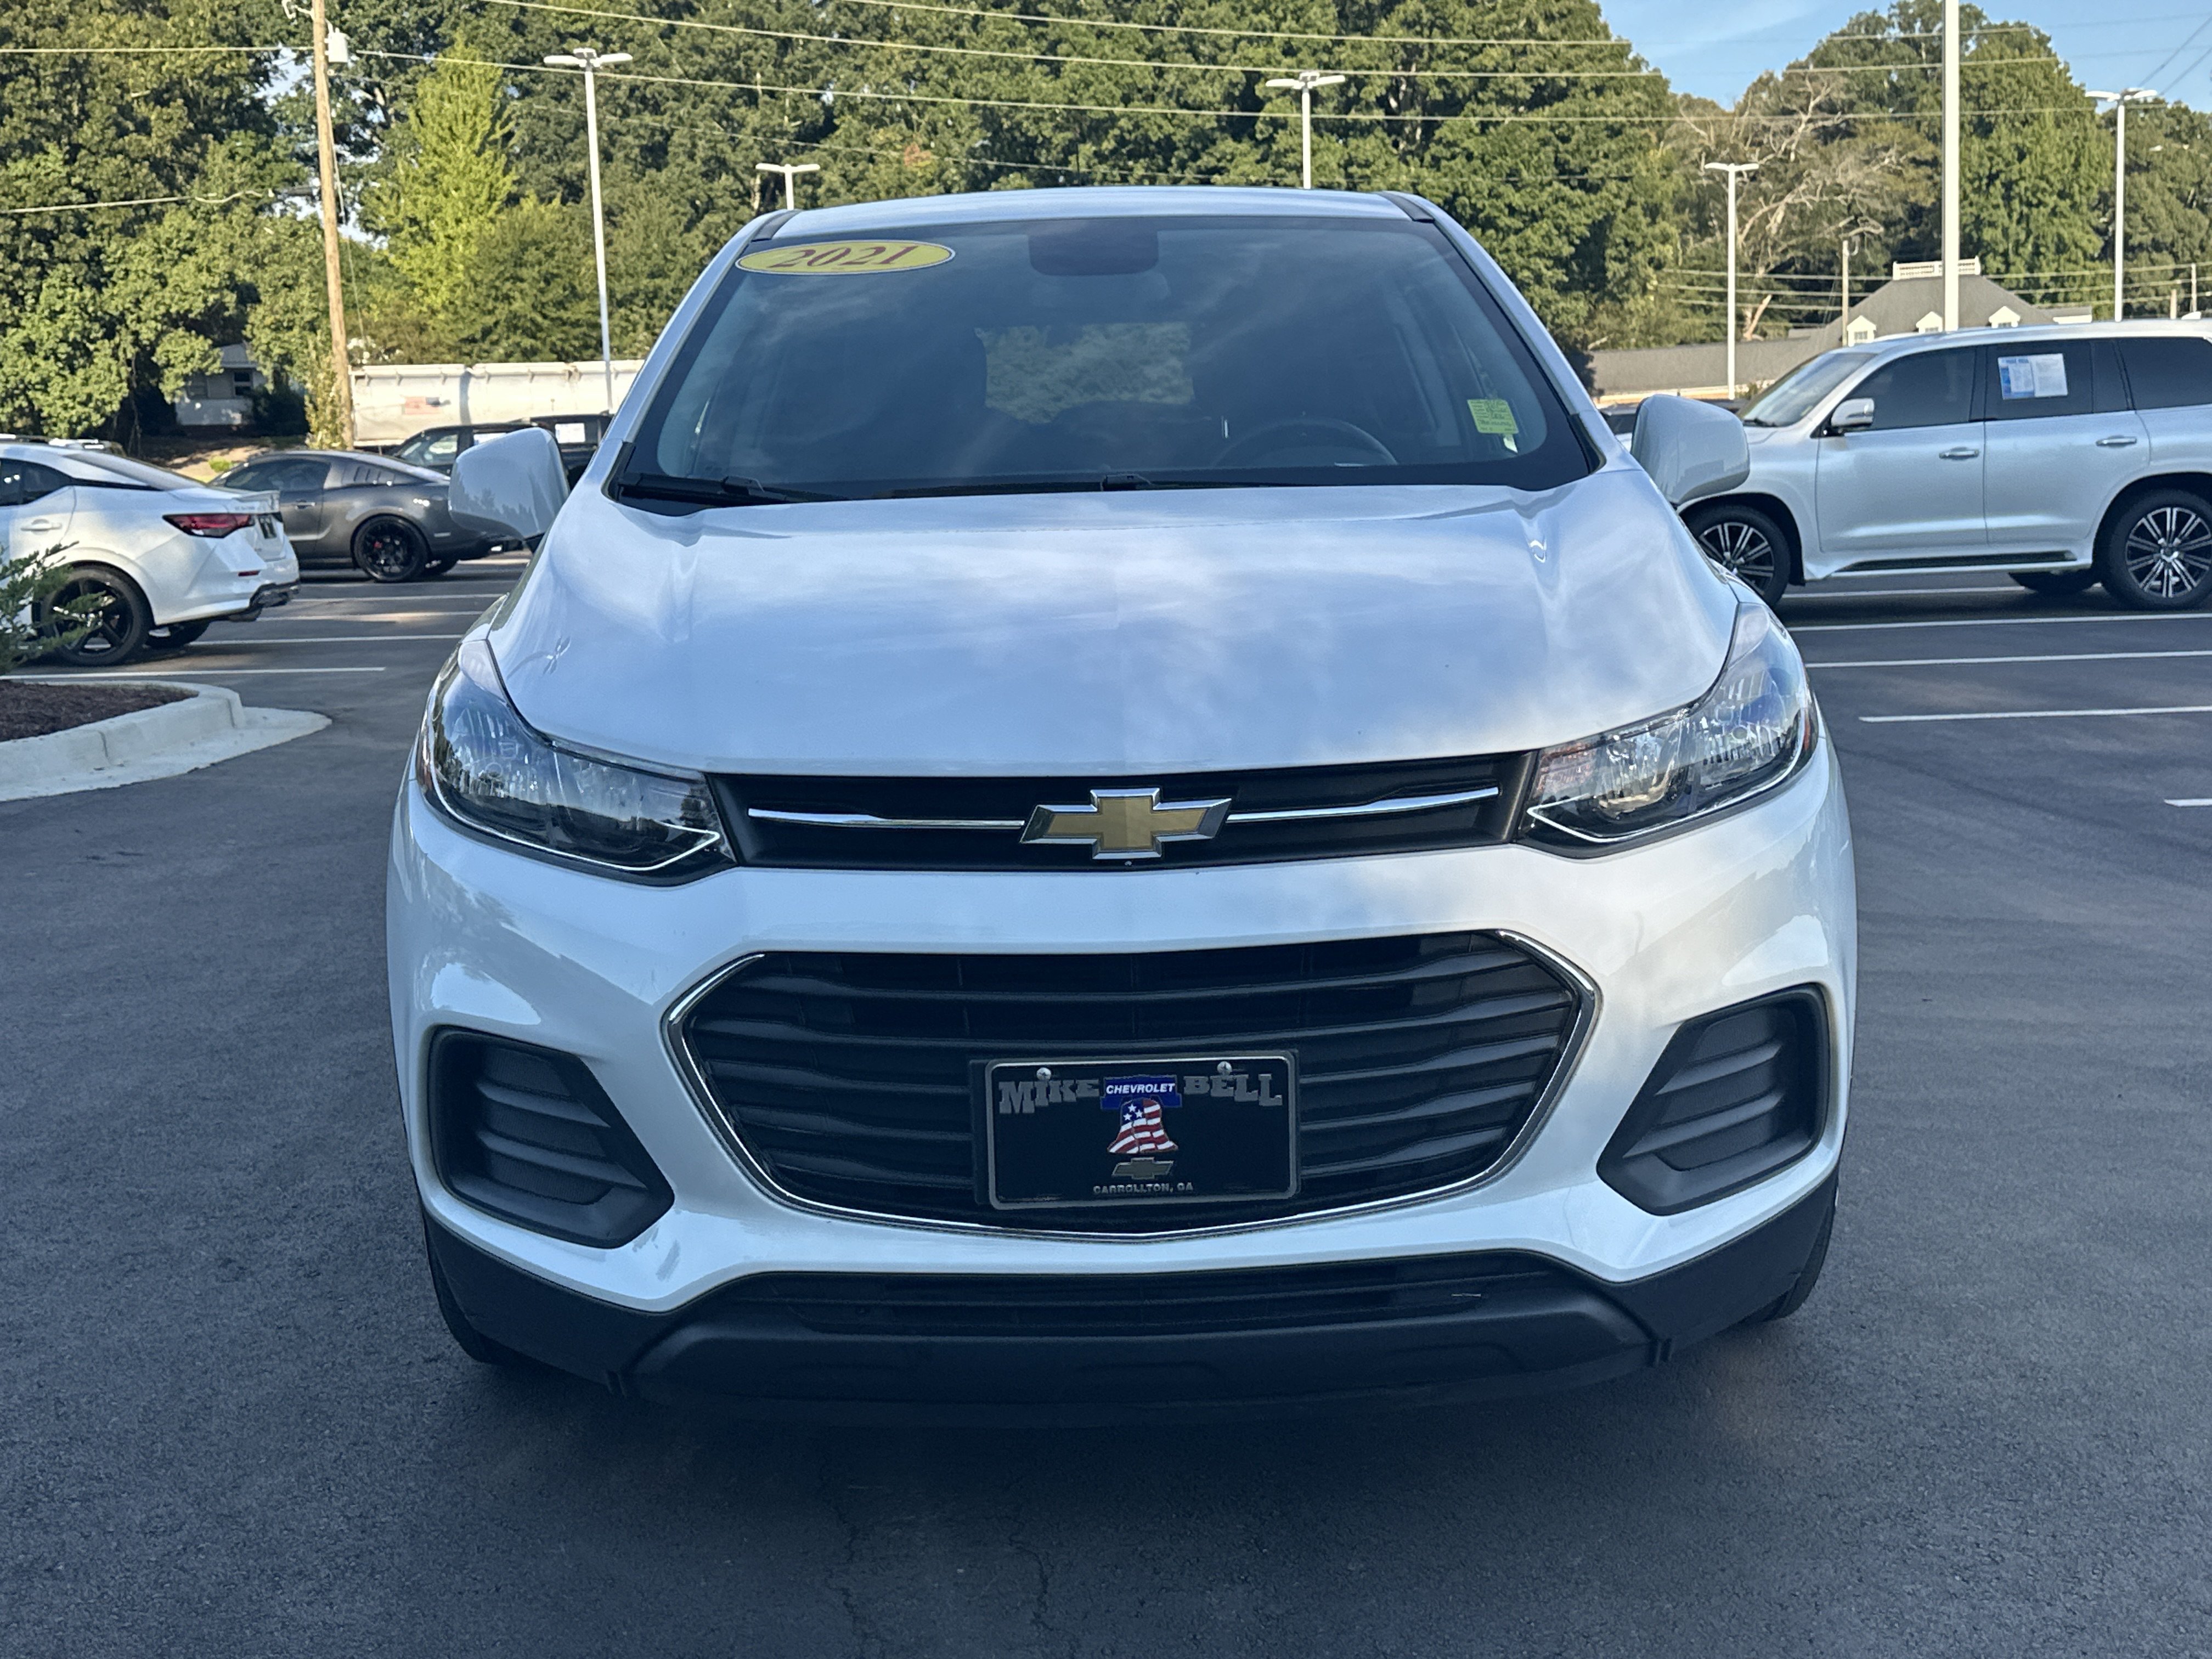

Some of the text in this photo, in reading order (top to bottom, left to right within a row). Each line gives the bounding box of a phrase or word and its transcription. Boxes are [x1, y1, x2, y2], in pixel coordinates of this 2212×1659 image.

[769, 245, 919, 268] 2021
[998, 1073, 1283, 1114] MIKE BELL
[1105, 1083, 1176, 1094] CHEVROLET
[1093, 1182, 1194, 1194] CARROLLTON, GA
